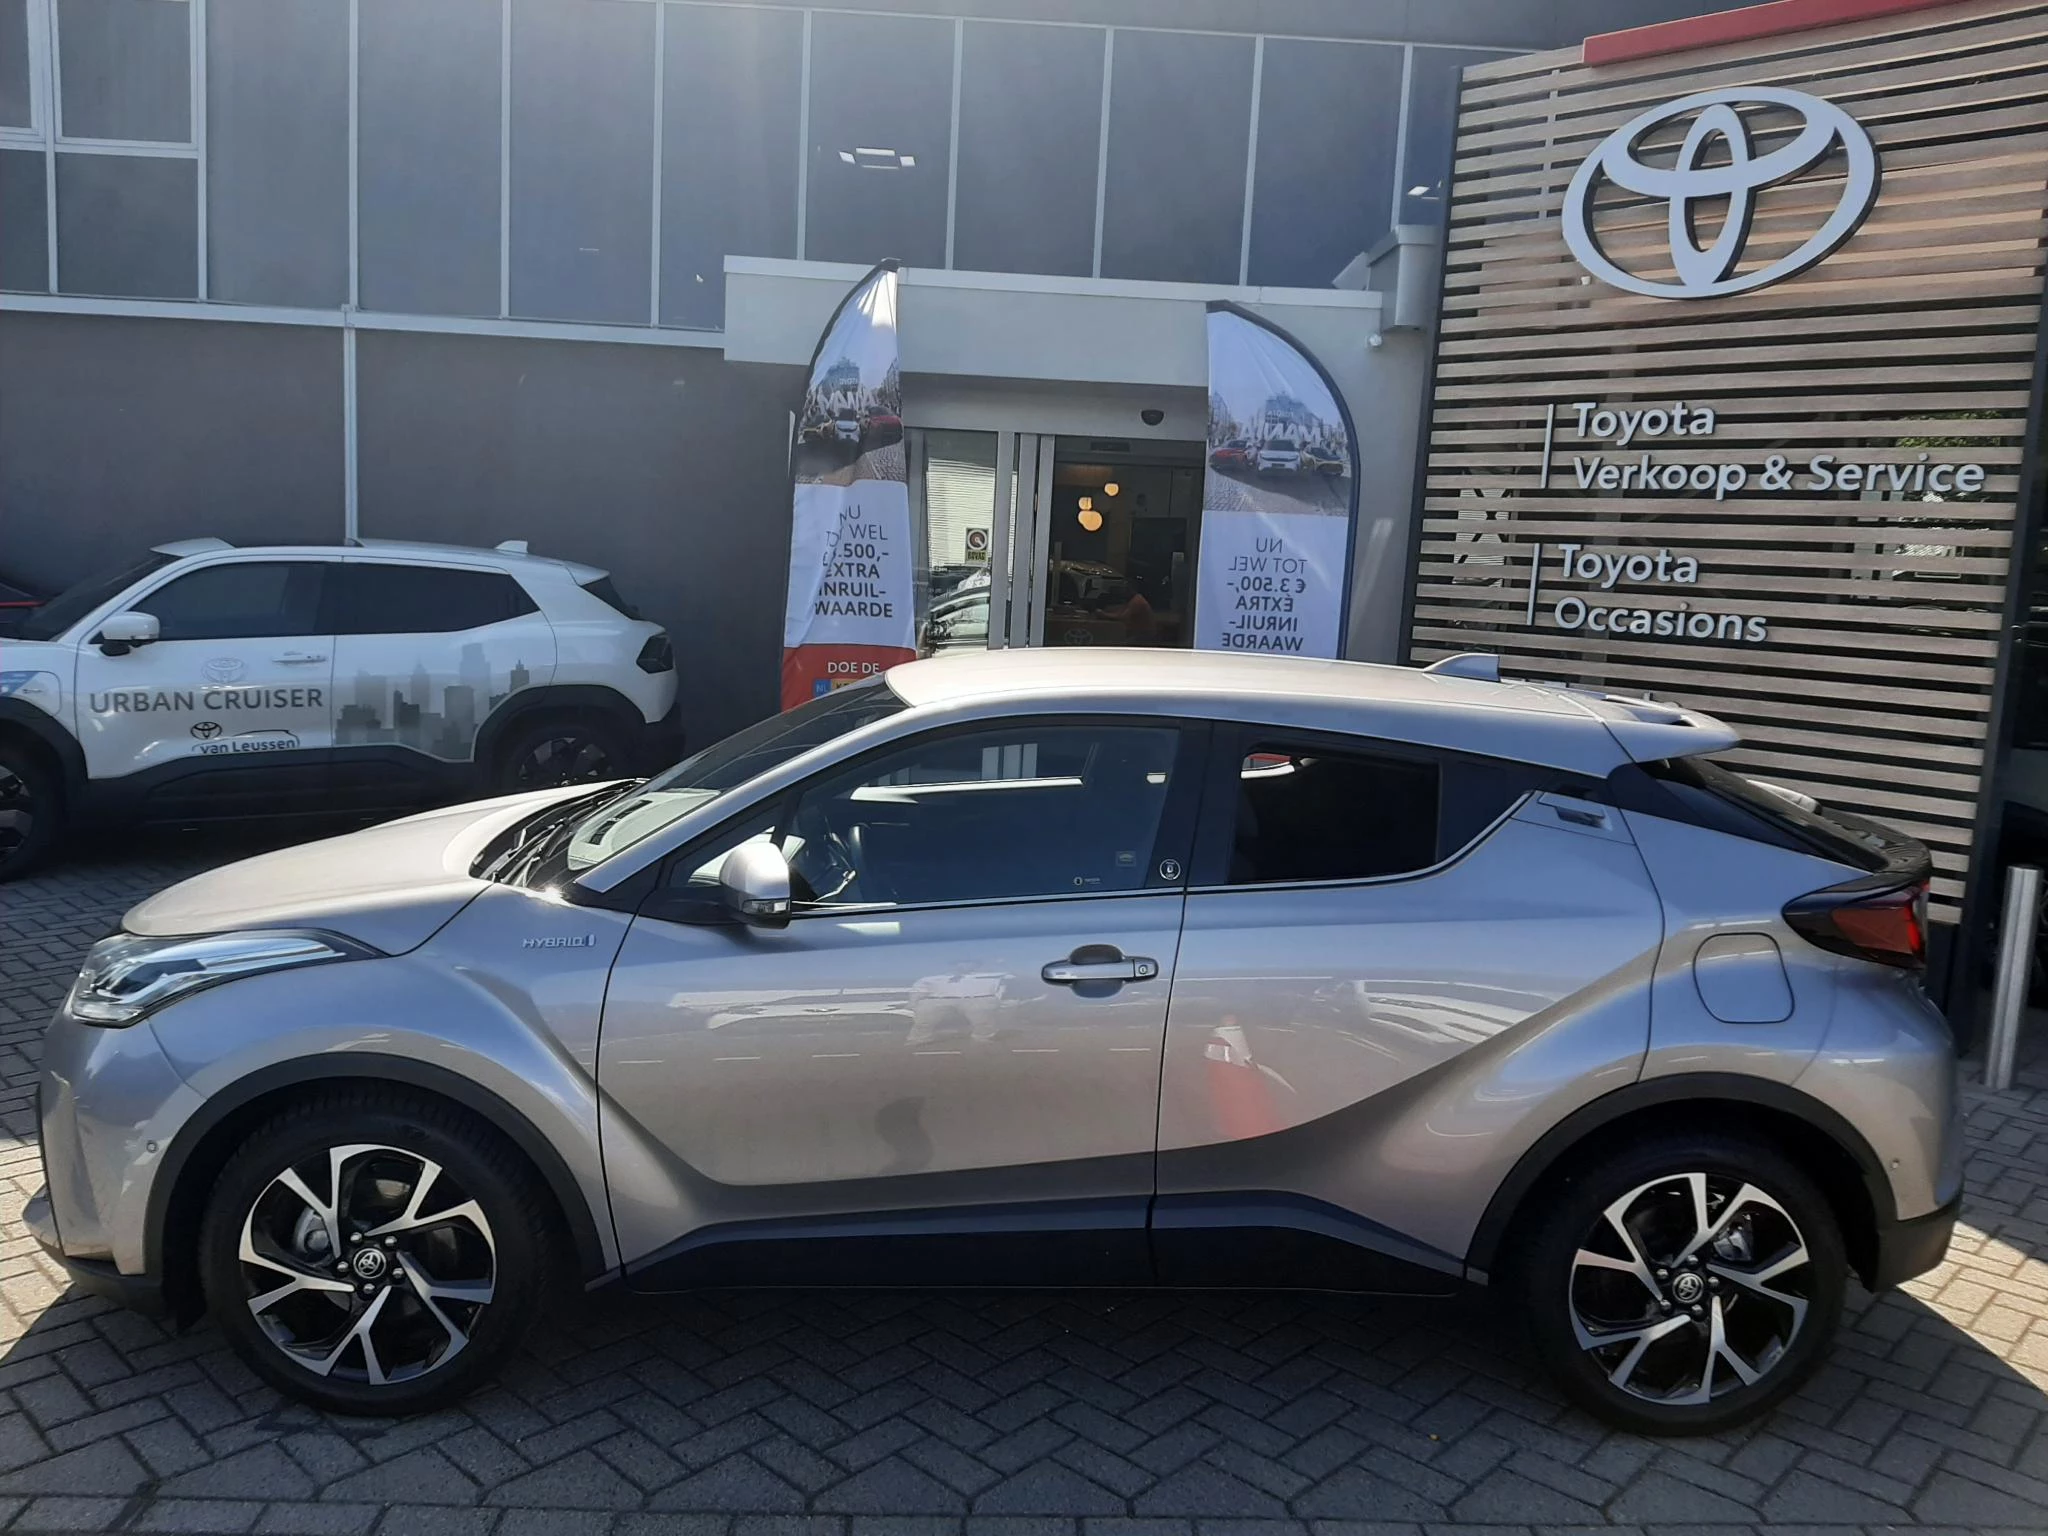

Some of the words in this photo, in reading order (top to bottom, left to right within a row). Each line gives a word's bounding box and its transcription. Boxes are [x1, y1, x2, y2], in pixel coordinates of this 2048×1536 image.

[1572, 402, 1715, 446] Toyota
[1573, 454, 1747, 500] Verkoop
[1760, 454, 1794, 491] &
[1807, 452, 1986, 493] Service
[849, 523, 888, 541] WEL
[1557, 543, 1699, 588] Toyota
[814, 601, 893, 618] WAARDE
[1554, 596, 1768, 643] Occasions
[827, 661, 858, 674] DOE
[862, 662, 880, 674] DE
[89, 691, 194, 714] URBAN
[203, 688, 323, 710] CRUISER
[200, 743, 229, 755] van
[233, 739, 295, 753] Leussen
[522, 936, 585, 948] HYBRID
